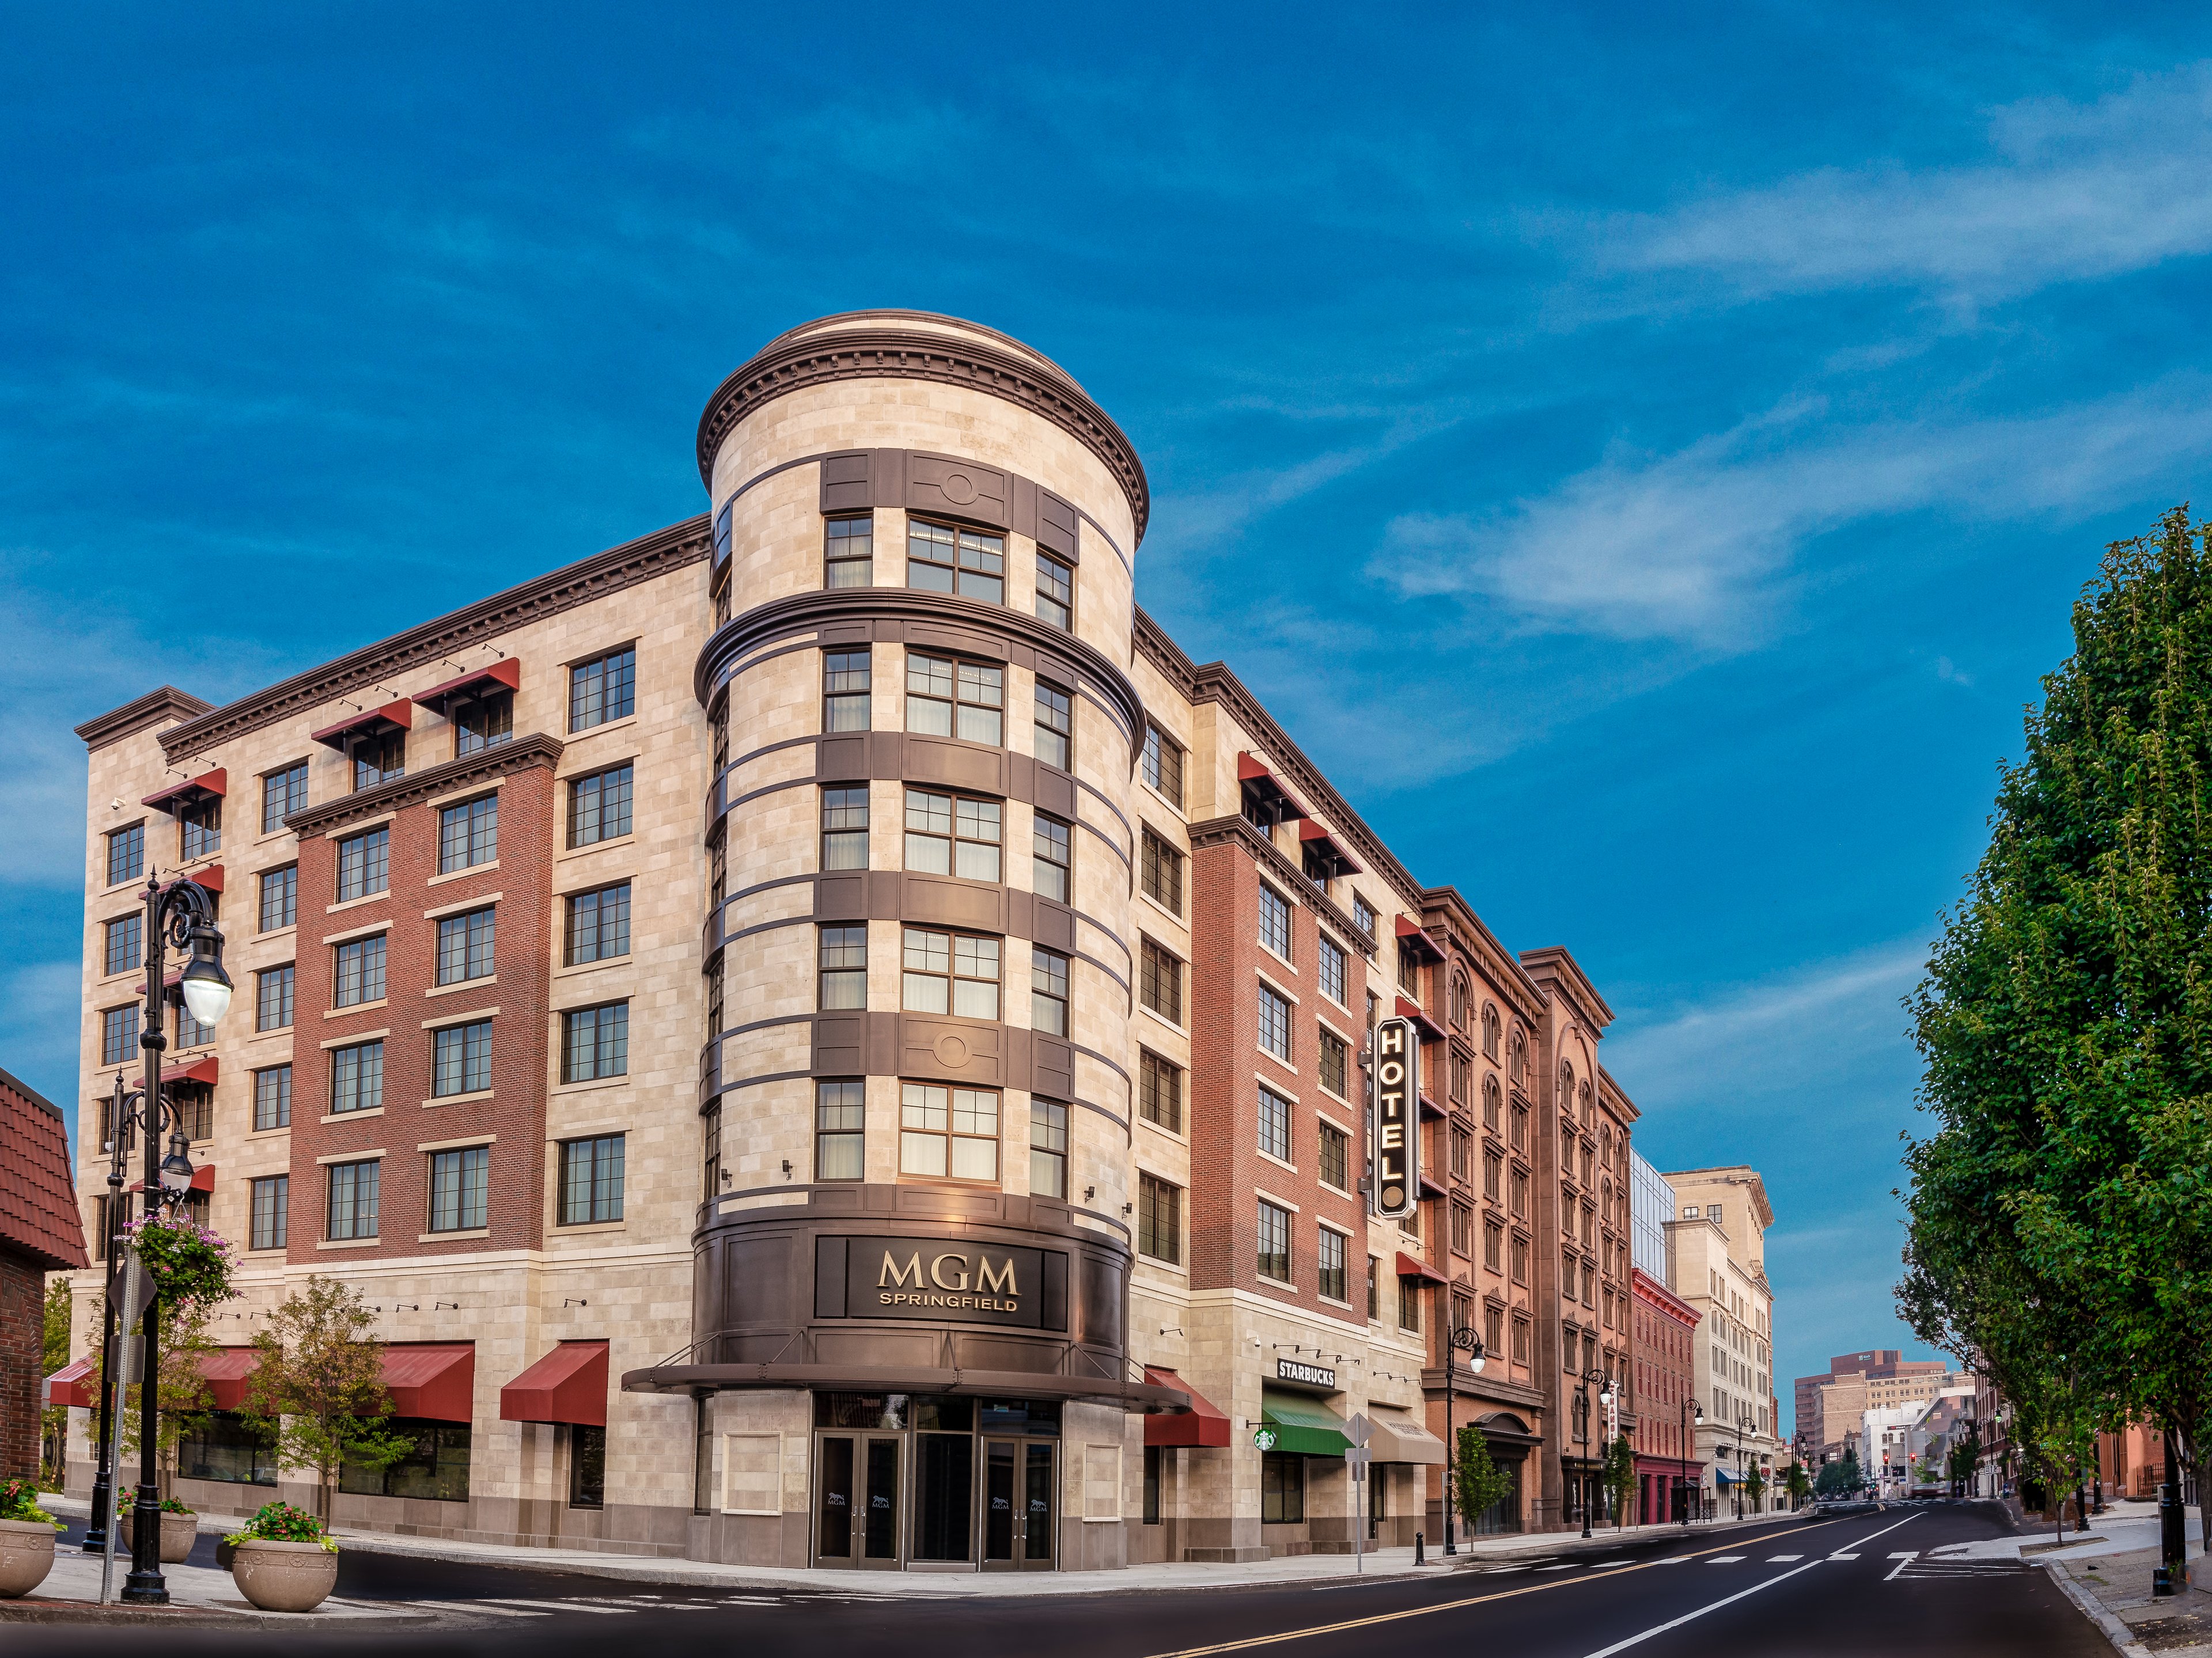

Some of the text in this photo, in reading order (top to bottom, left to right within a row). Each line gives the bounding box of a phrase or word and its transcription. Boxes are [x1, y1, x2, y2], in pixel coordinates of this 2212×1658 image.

[1380, 1029, 1404, 1181] HOTEL
[876, 1249, 1022, 1296] MGM
[880, 1293, 1018, 1312] SPRINGFIELD
[1279, 1361, 1334, 1386] STARBUCKS
